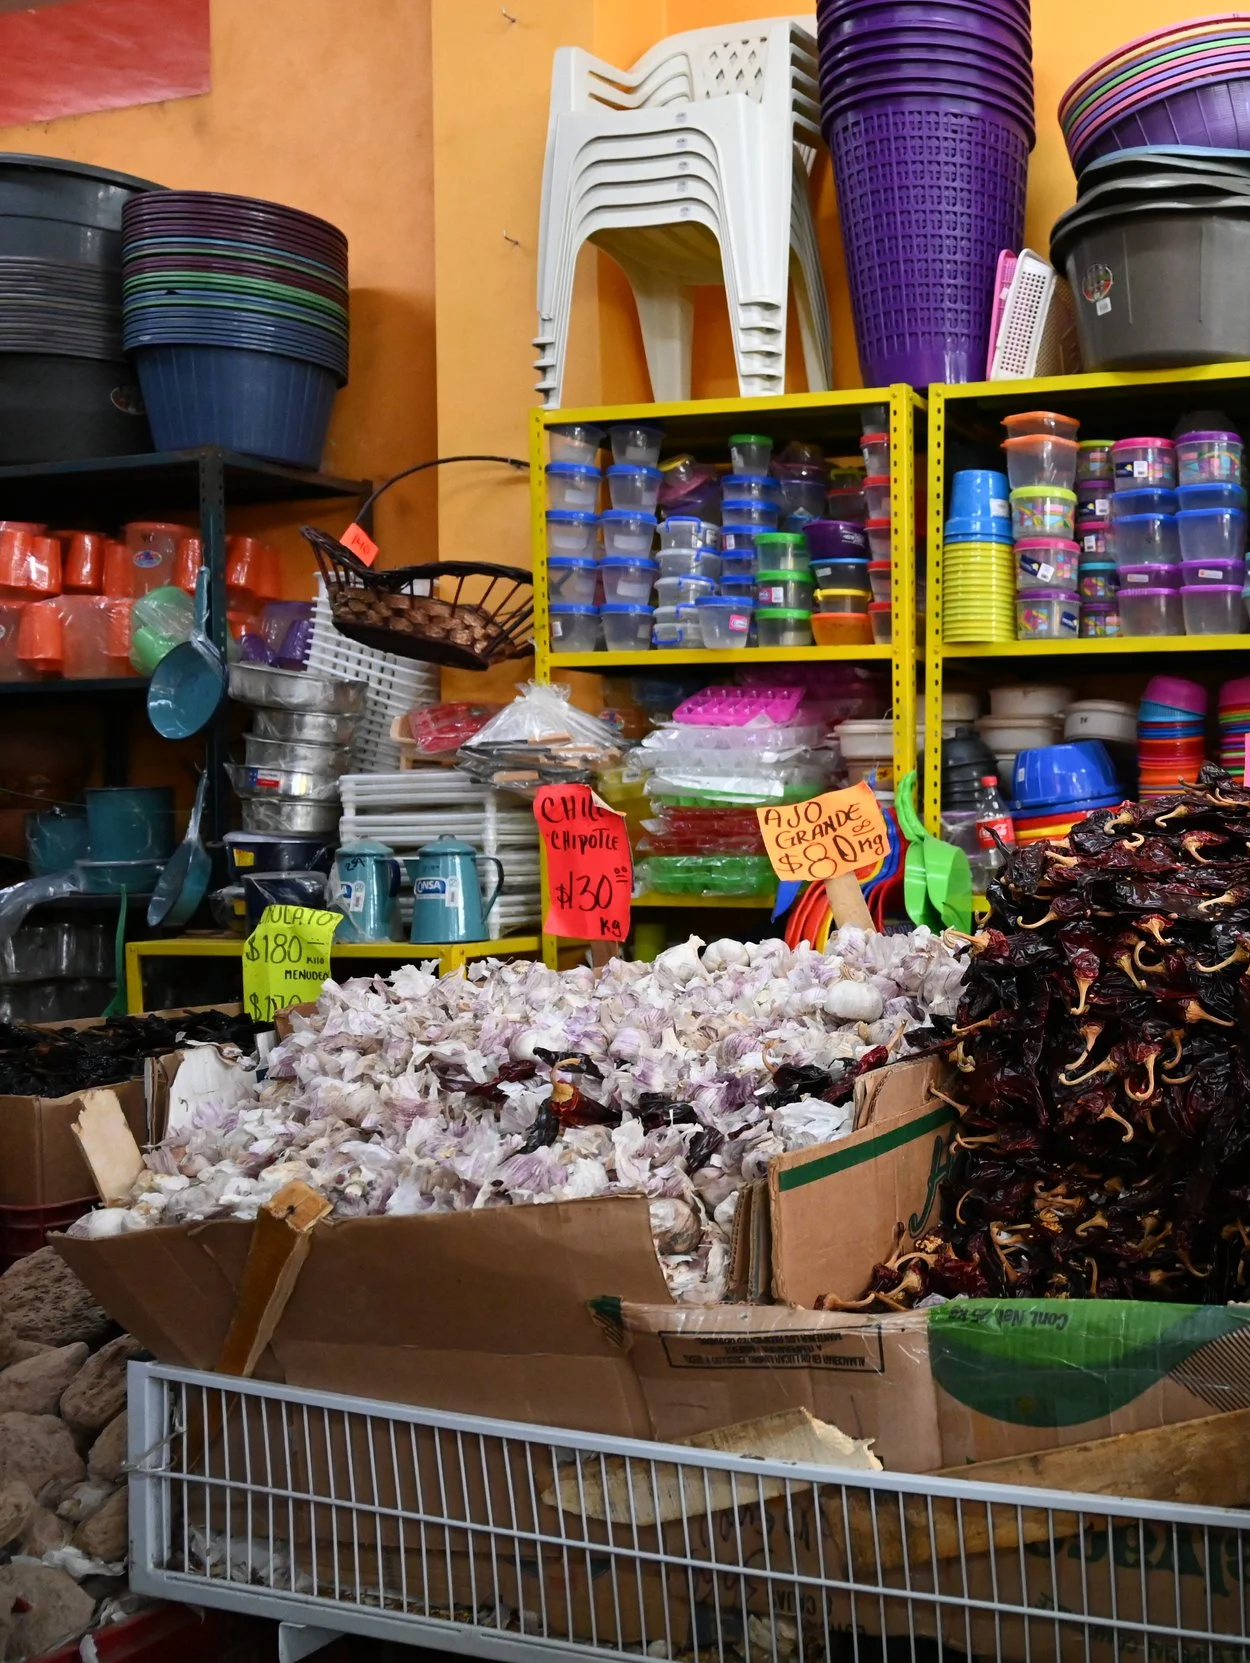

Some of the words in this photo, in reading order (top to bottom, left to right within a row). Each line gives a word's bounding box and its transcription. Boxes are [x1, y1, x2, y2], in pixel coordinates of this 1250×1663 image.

[764, 801, 822, 829] AJO
[775, 802, 862, 849] GRANDE
[555, 871, 613, 912] $130
[245, 934, 303, 964] $180
[285, 969, 329, 981] MENUDEO
